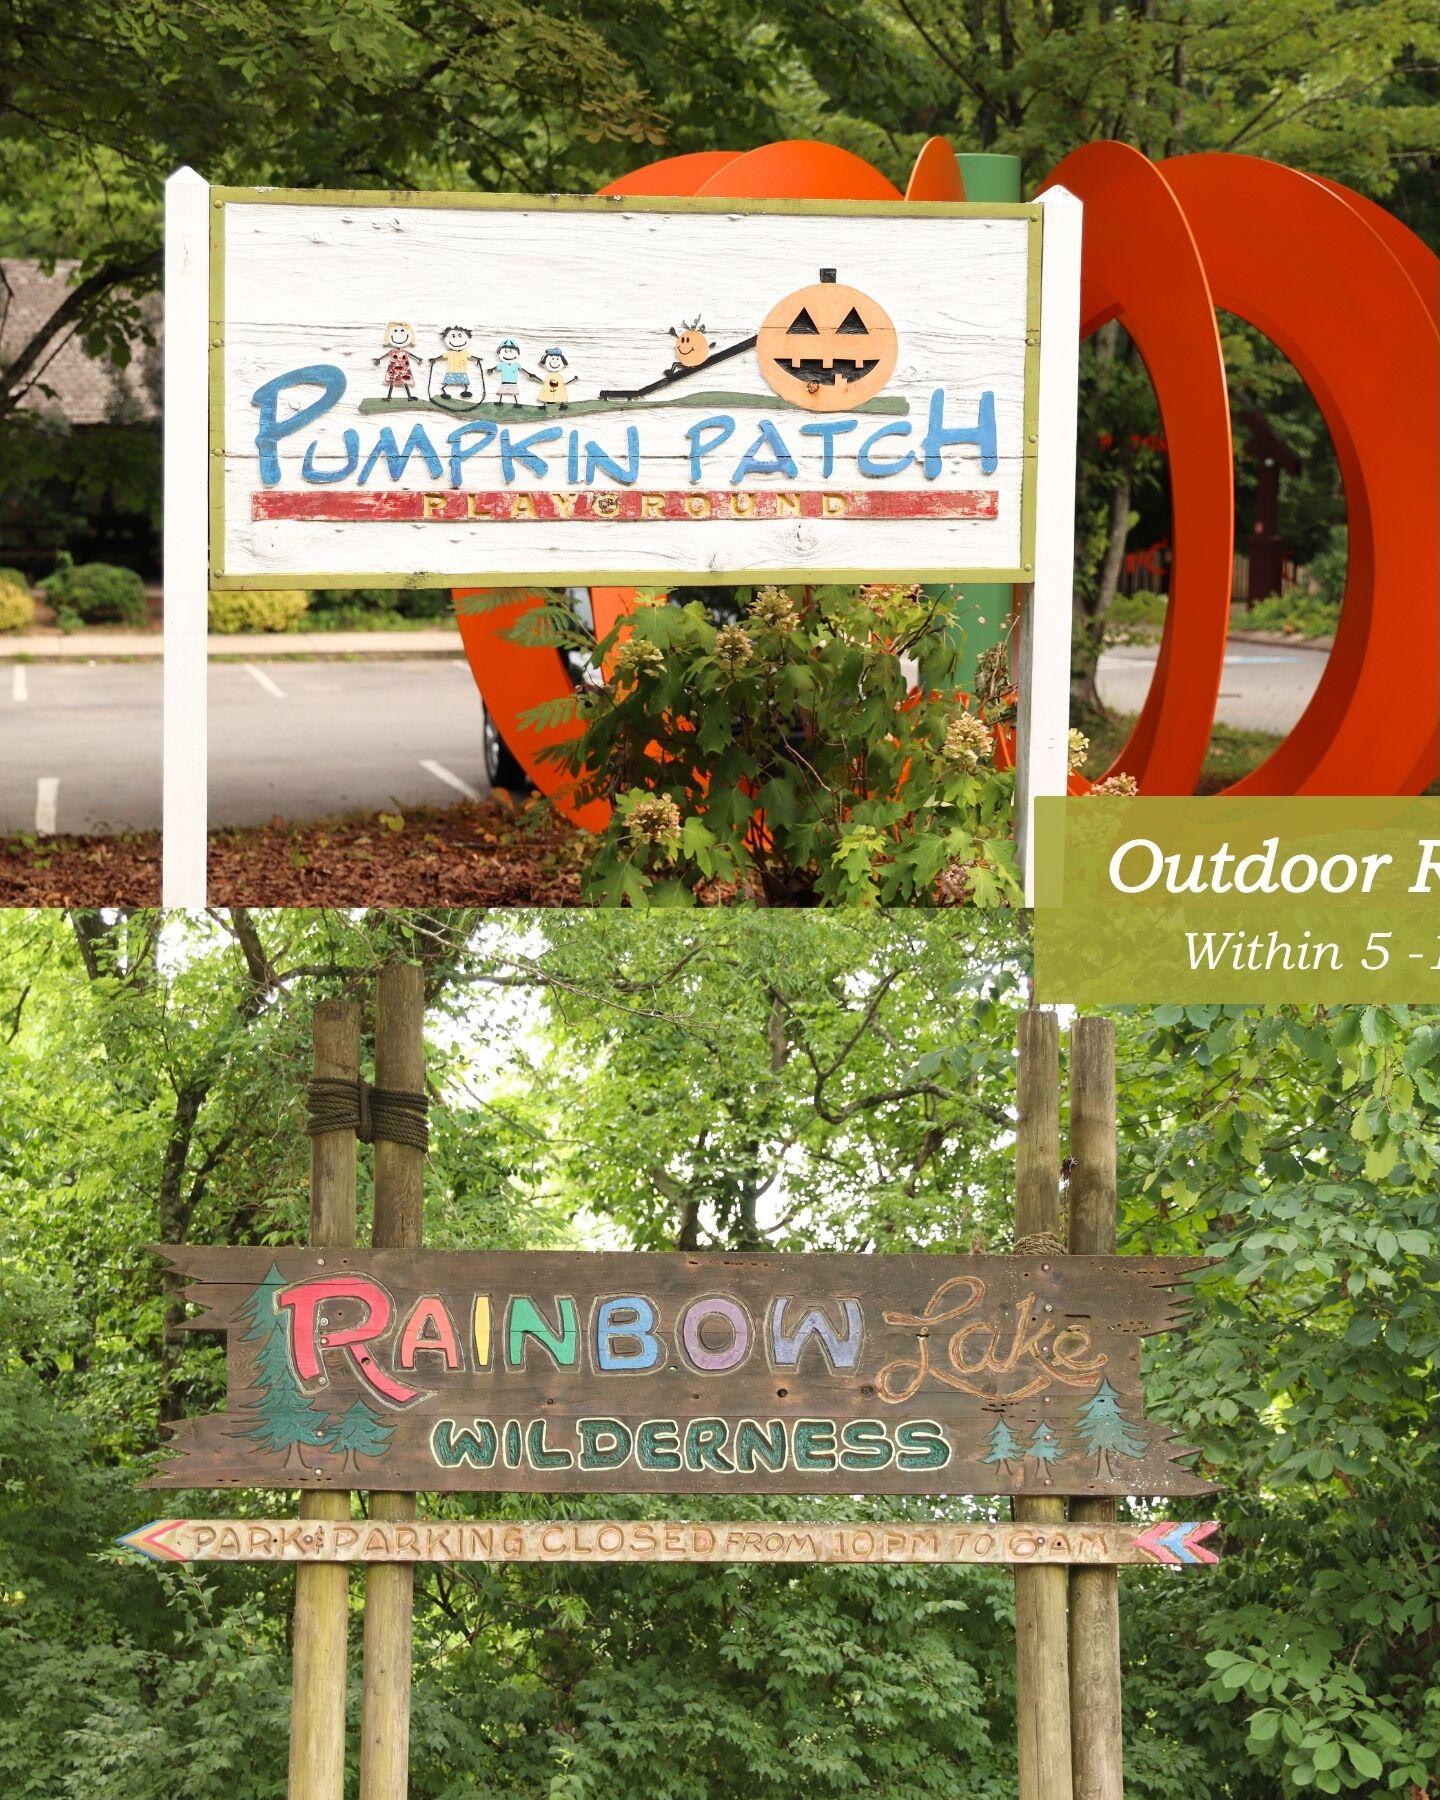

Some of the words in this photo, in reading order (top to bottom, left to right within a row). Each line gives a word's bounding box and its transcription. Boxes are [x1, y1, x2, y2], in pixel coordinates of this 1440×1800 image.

[686, 388, 999, 485] PATCH
[421, 492, 848, 520] PLAYGROUND
[276, 1271, 868, 1412] RAINBOW
[873, 1275, 1109, 1404] Lake
[429, 1416, 952, 1474] WILDERNESS
[193, 1526, 303, 1555] PARK
[329, 1525, 524, 1557] PARKING
[540, 1525, 716, 1554] CLOSED
[723, 1531, 818, 1556] FROM
[955, 1531, 997, 1556] TO
